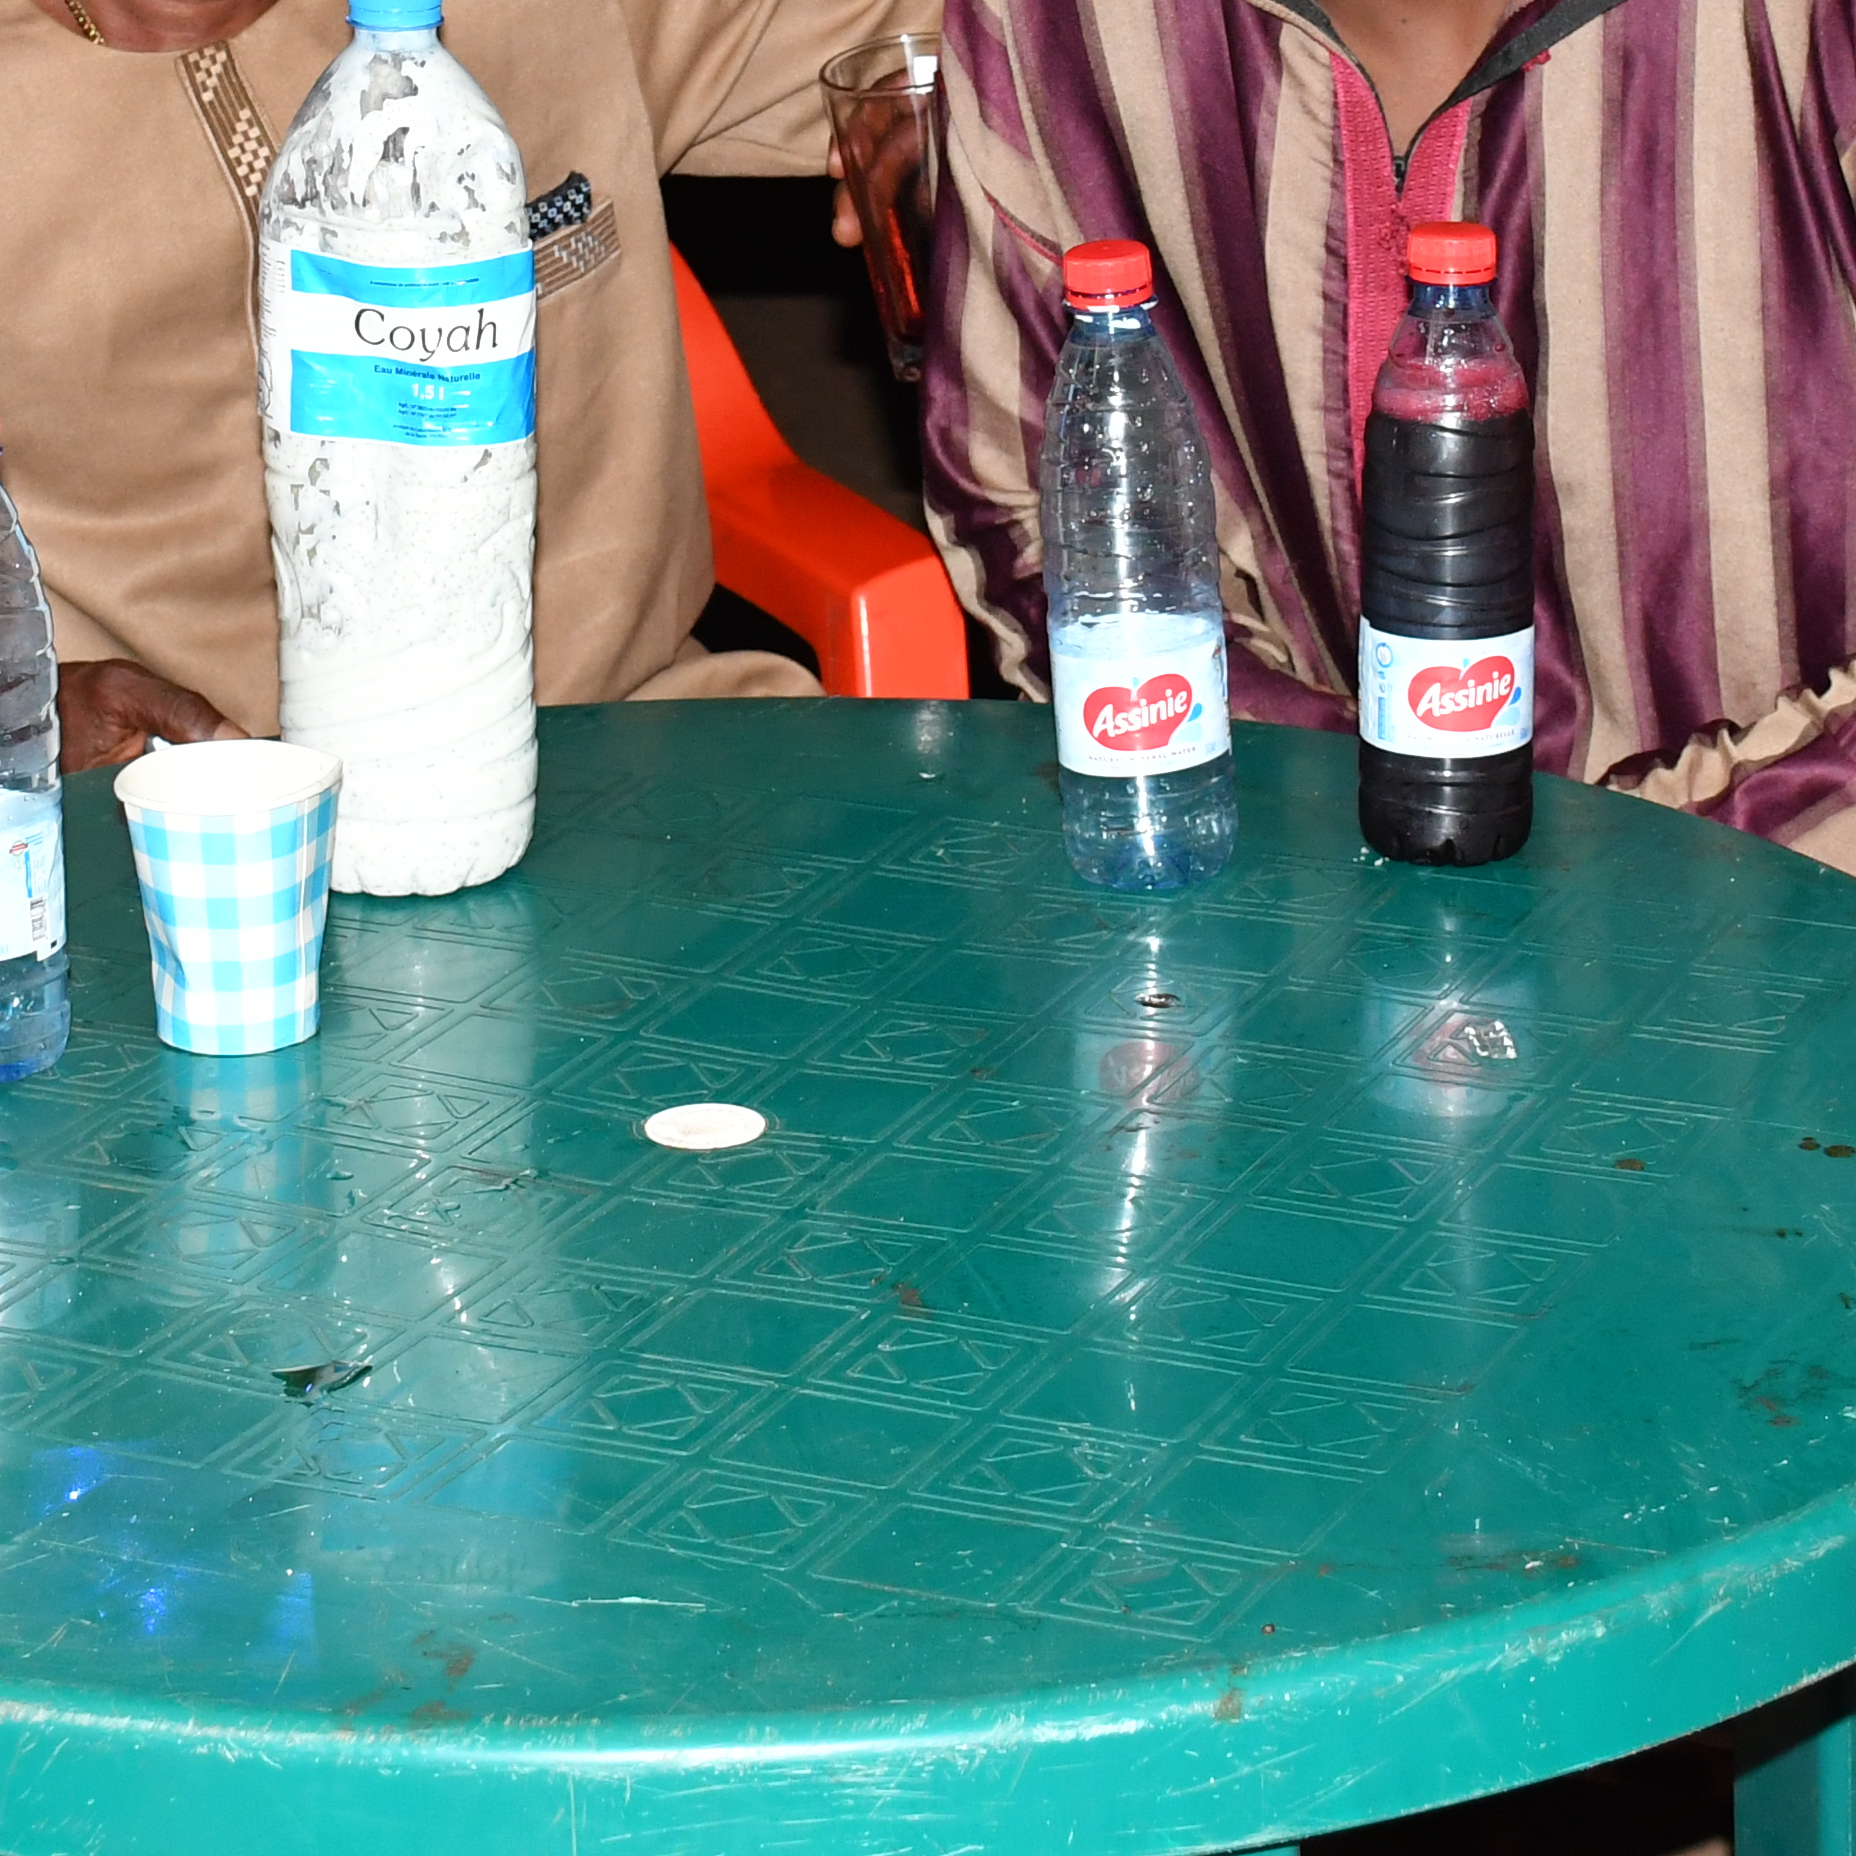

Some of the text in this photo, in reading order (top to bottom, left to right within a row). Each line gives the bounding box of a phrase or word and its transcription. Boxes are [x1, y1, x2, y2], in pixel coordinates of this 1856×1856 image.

[354, 307, 498, 362] Coyah
[374, 364, 393, 375] Eau
[437, 372, 481, 383] Naturelle
[1092, 688, 1188, 738] Assinie
[1416, 670, 1512, 718] Assinie
